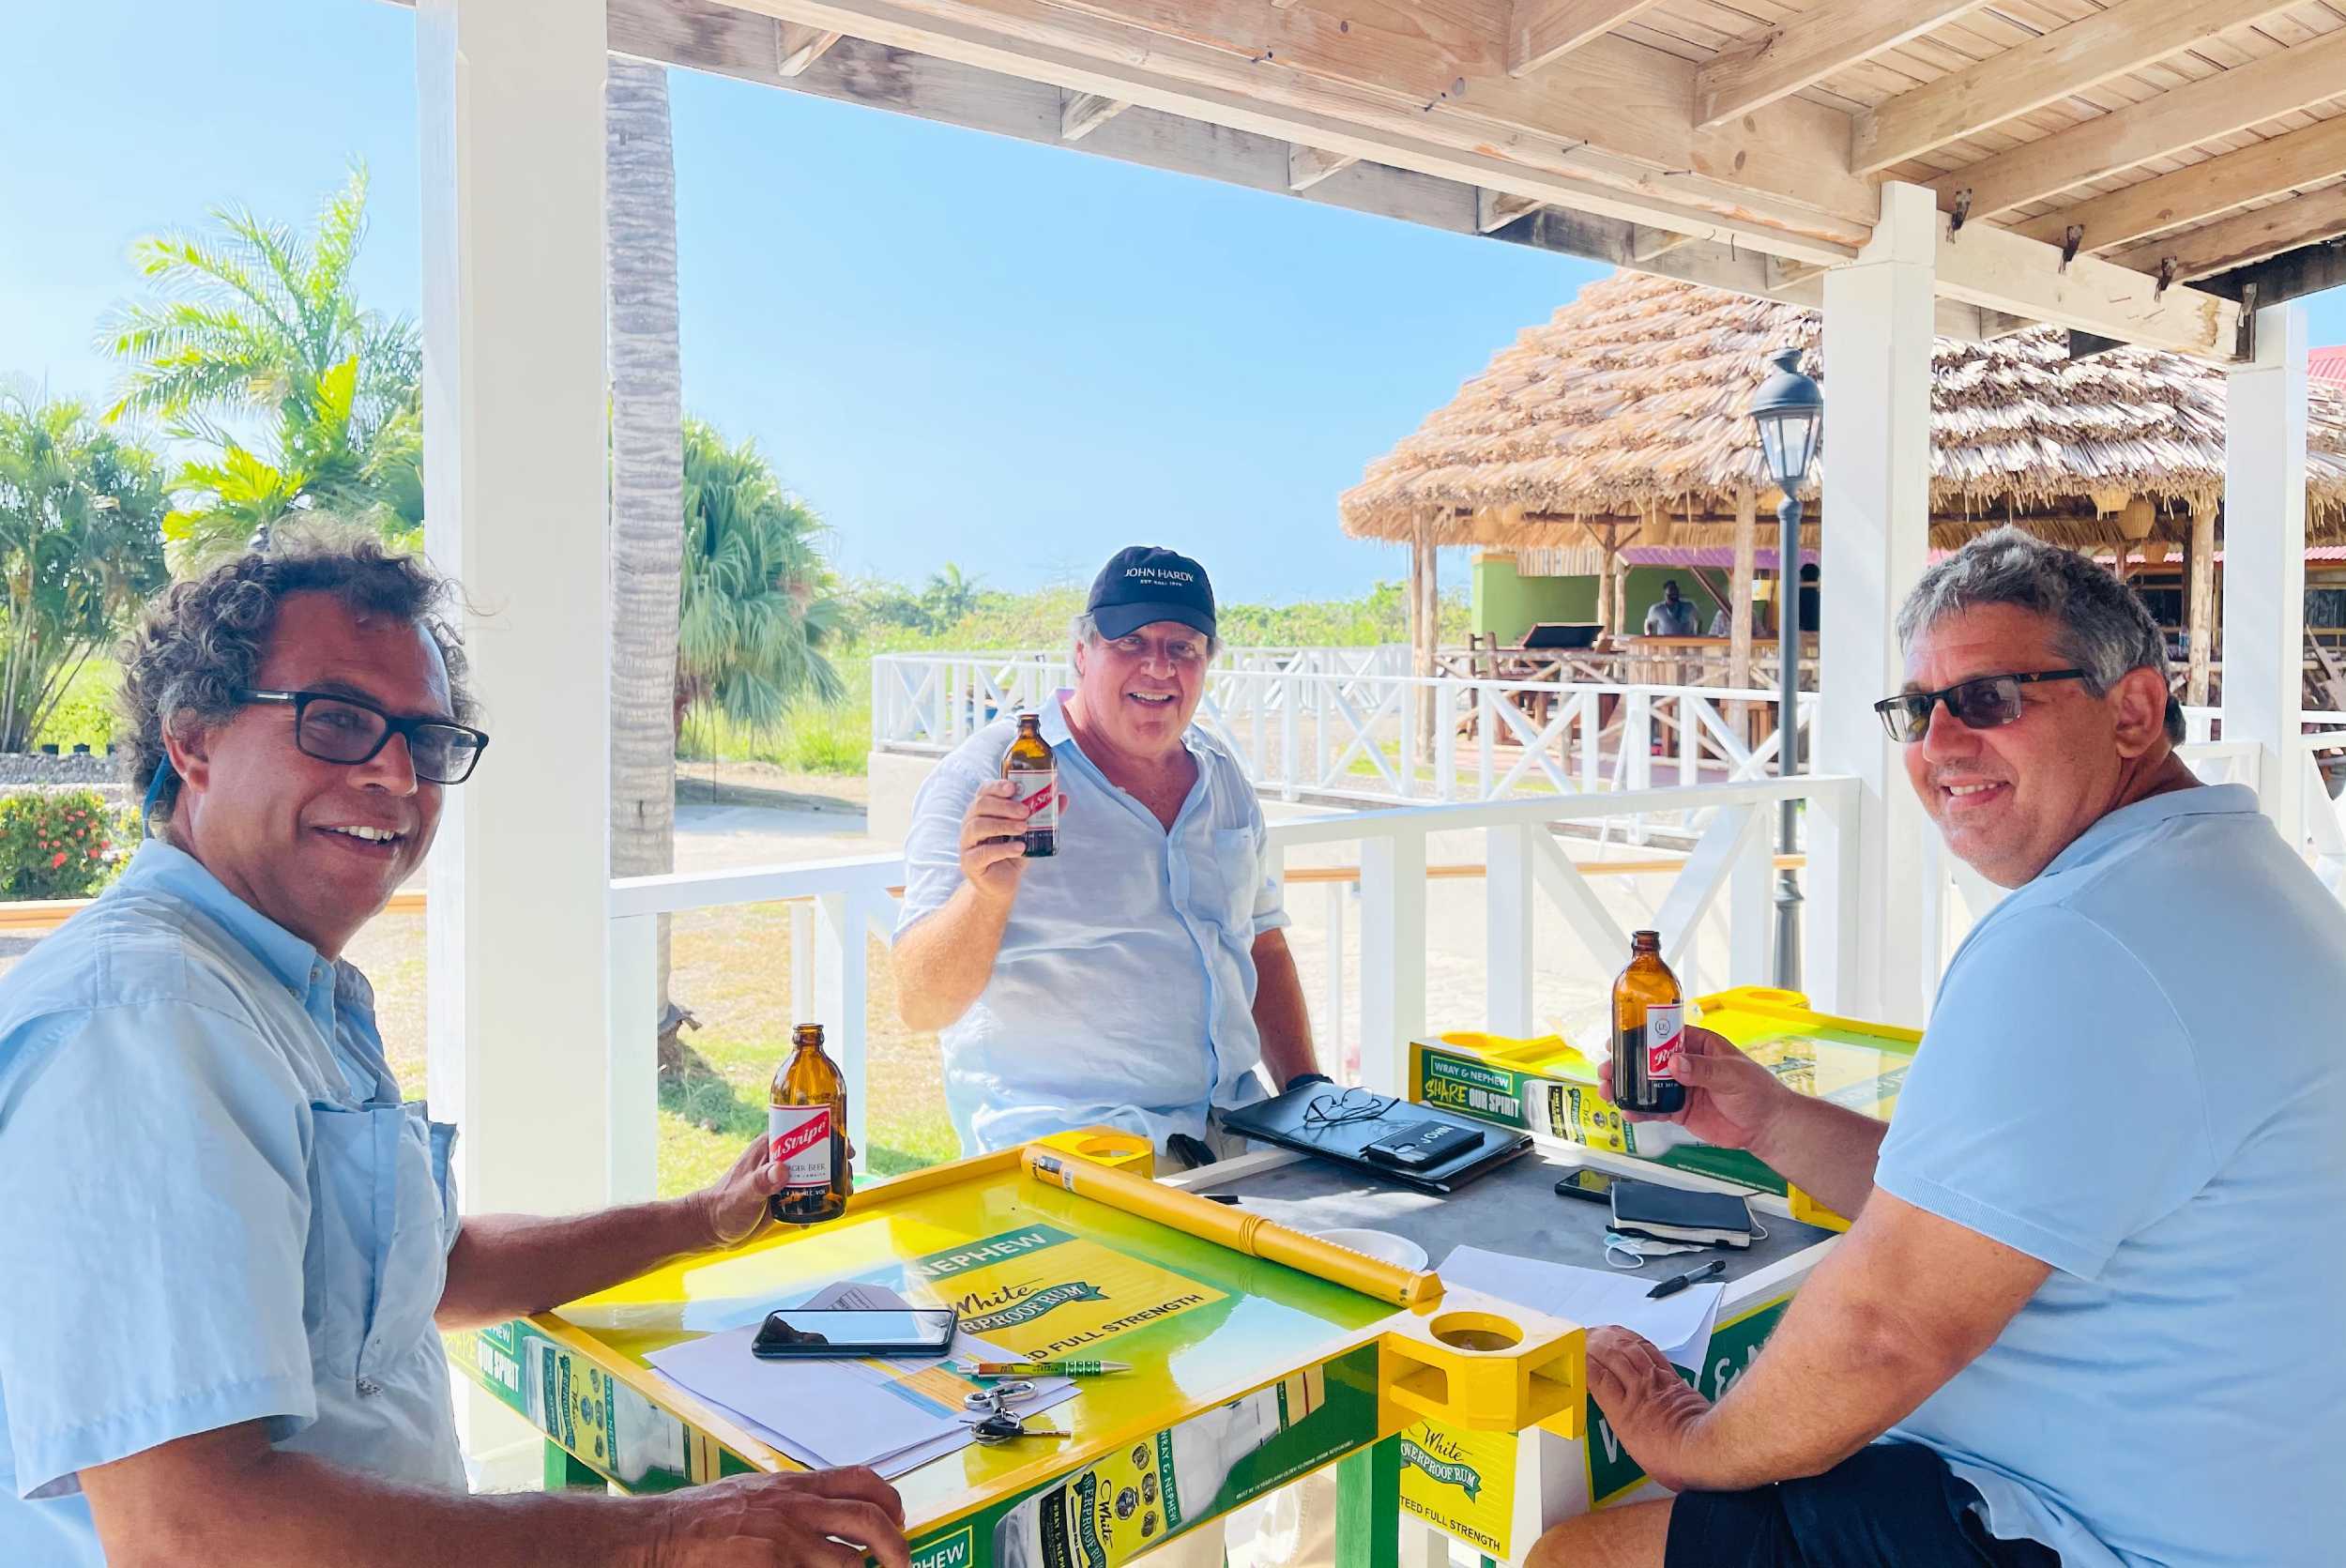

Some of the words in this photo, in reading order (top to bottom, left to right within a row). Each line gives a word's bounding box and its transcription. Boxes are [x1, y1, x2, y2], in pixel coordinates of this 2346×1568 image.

[1124, 568, 1155, 577] JOHN
[1157, 569, 1194, 582] HARDY
[1434, 1061, 1458, 1076] WRAY
[1460, 1068, 1470, 1078] &
[1470, 1071, 1508, 1088] NEPHEW
[1425, 1077, 1468, 1103] SHARE
[1469, 1088, 1488, 1110] OUR
[1488, 1092, 1520, 1119] SPIRIT
[783, 1122, 826, 1153] Stripe
[808, 1164, 827, 1172] BEER
[954, 1278, 1044, 1319] White
[958, 1302, 1044, 1332] RPROOF
[1038, 1285, 1087, 1305] RUM
[1048, 1332, 1104, 1352] FULL
[1102, 1294, 1205, 1332] STRENGTH
[1408, 1421, 1473, 1462] White
[1163, 1464, 1171, 1473] &
[1400, 1442, 1455, 1480] OVERPROOF
[1455, 1469, 1476, 1487] RUM
[1082, 1477, 1097, 1549] OVERPROOF
[1099, 1480, 1114, 1548] White
[1165, 1477, 1177, 1522] NEPHEW
[1400, 1496, 1423, 1514] TEED
[1424, 1508, 1447, 1527] FULL
[1450, 1519, 1501, 1551] STRENGTH
